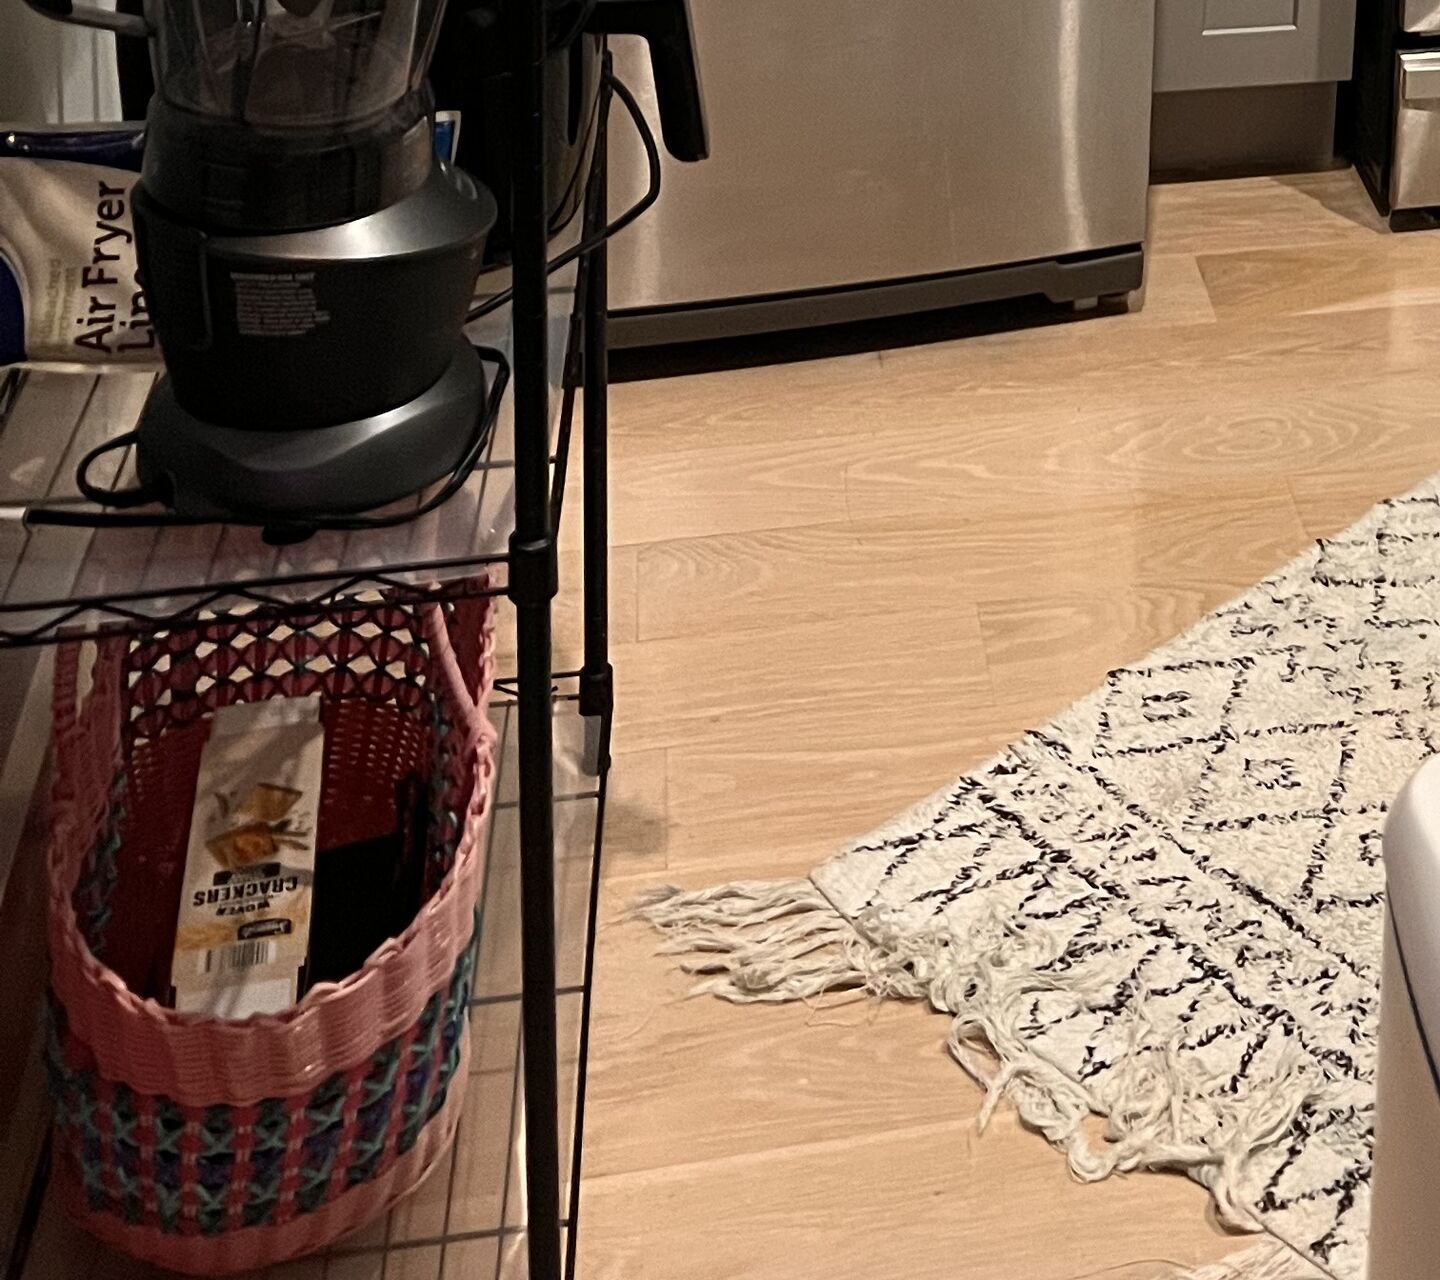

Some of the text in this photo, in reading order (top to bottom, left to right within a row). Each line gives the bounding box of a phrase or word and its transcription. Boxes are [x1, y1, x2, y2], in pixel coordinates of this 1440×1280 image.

[81, 181, 133, 289] Fryer
[74, 296, 116, 353] Air
[193, 876, 298, 907] CRACKERS
